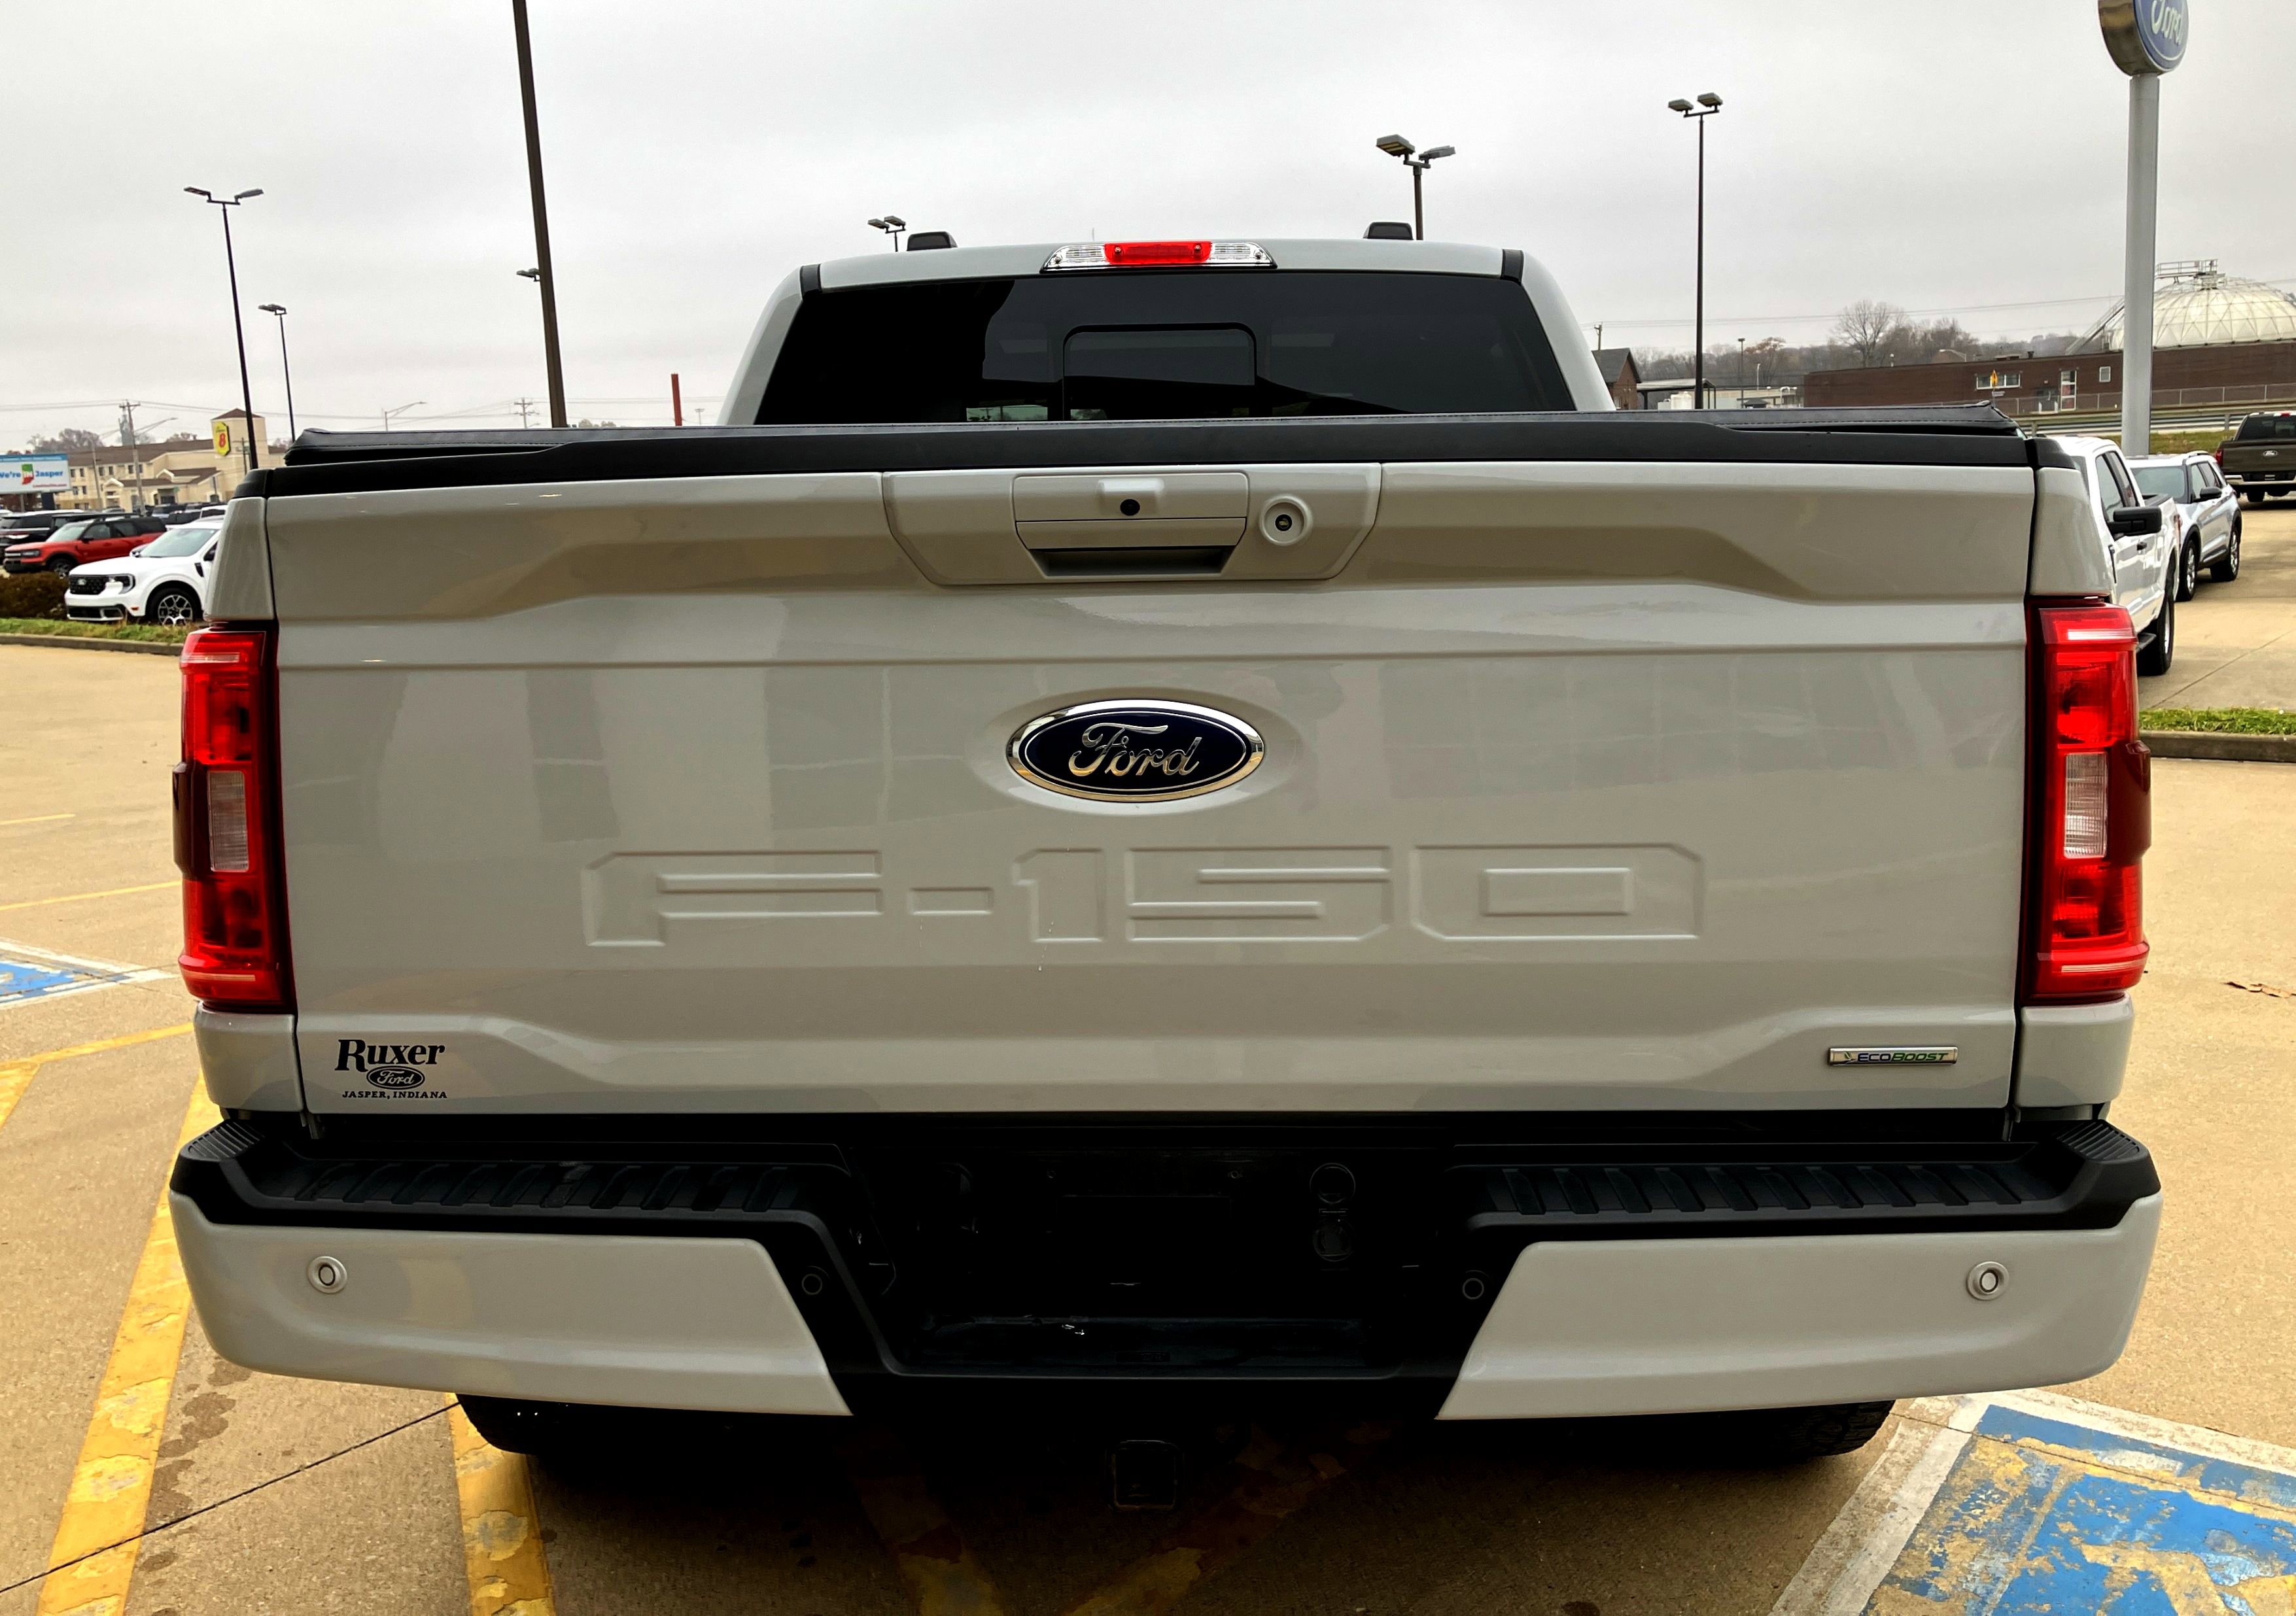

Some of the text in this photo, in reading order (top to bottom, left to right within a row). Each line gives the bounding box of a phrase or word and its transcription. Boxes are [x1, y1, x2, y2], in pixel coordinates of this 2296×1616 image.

[219, 433, 226, 448] 8
[1068, 723, 1202, 777] Ford
[582, 843, 1705, 948] F-150
[334, 1039, 445, 1073] Ruxer
[377, 1069, 415, 1086] Ford
[342, 1090, 447, 1099] JASPER, INDIANA
